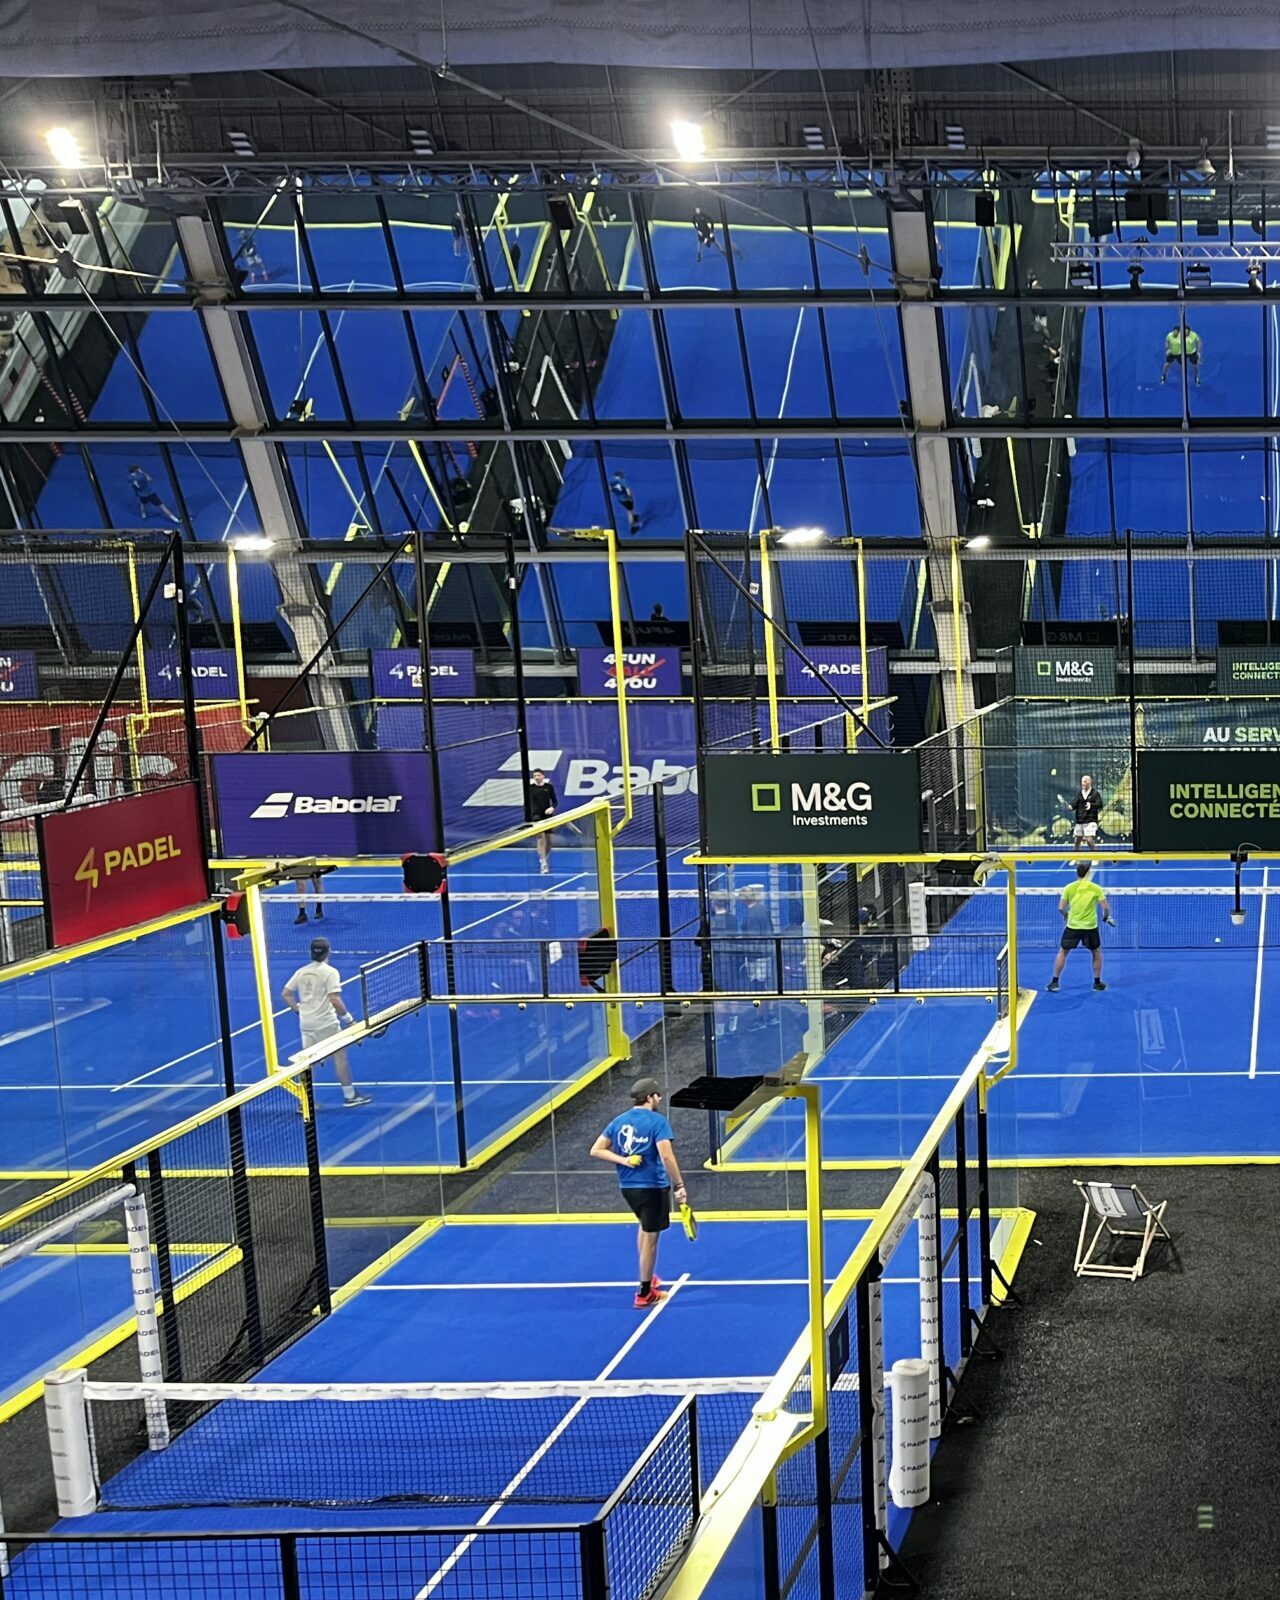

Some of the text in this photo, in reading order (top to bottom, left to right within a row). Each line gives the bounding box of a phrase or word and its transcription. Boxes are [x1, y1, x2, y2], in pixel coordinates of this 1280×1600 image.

[818, 664, 867, 674] PADE
[1055, 661, 1094, 676] M&G
[1203, 727, 1230, 742] AU
[791, 782, 873, 811] M&G
[792, 815, 869, 827] Investments
